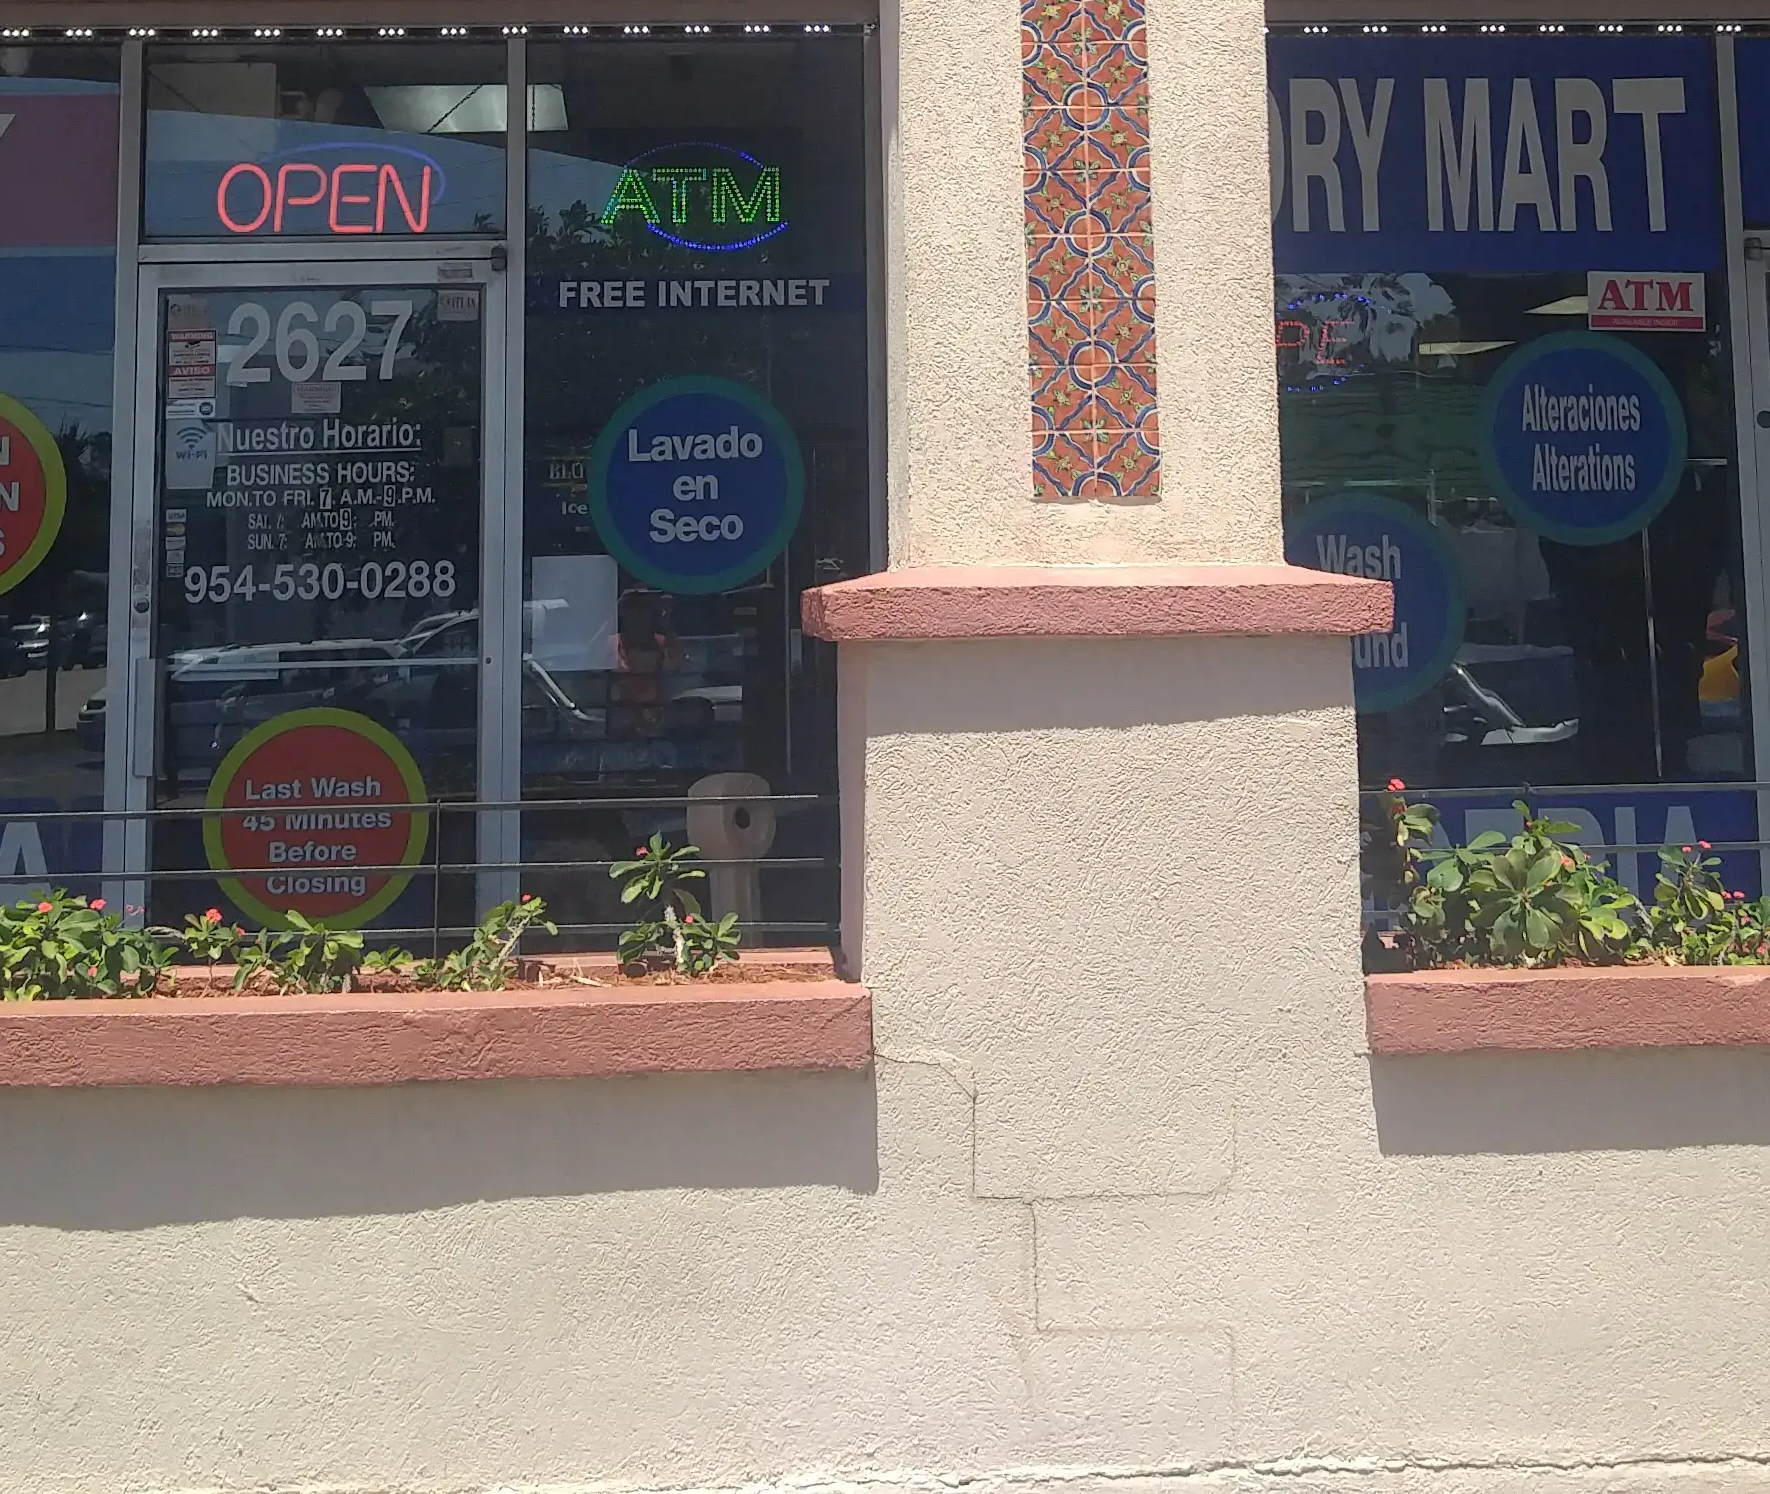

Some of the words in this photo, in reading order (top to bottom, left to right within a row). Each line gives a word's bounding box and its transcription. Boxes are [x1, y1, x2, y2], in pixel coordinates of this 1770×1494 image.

[1424, 77, 1686, 233] MART
[217, 163, 431, 234] OPEN
[601, 166, 781, 225] ATM
[560, 280, 646, 308] FREE
[659, 279, 830, 306] INTERNET
[1597, 279, 1694, 312] ATM
[227, 301, 413, 382] 2627
[173, 366, 210, 375] AVISO
[1522, 384, 1641, 433] Alteraciones
[218, 421, 315, 452] Nuestro
[323, 418, 422, 449] Horario:
[629, 425, 763, 463] Lavado
[227, 462, 329, 486] BUSINESS
[337, 460, 415, 483] HOURS:
[672, 473, 717, 500] en
[1533, 444, 1636, 494] Alterations
[283, 488, 315, 506] FRI.
[649, 507, 745, 543] Seco
[1317, 534, 1402, 581] Wash
[184, 560, 456, 603] 954-530-0288
[1354, 628, 1409, 670] und
[245, 778, 302, 800] Last
[311, 776, 382, 798] Wash
[243, 814, 276, 832] 45
[285, 808, 393, 830] Minutes
[269, 840, 358, 864] Before
[266, 872, 367, 897] Closing
